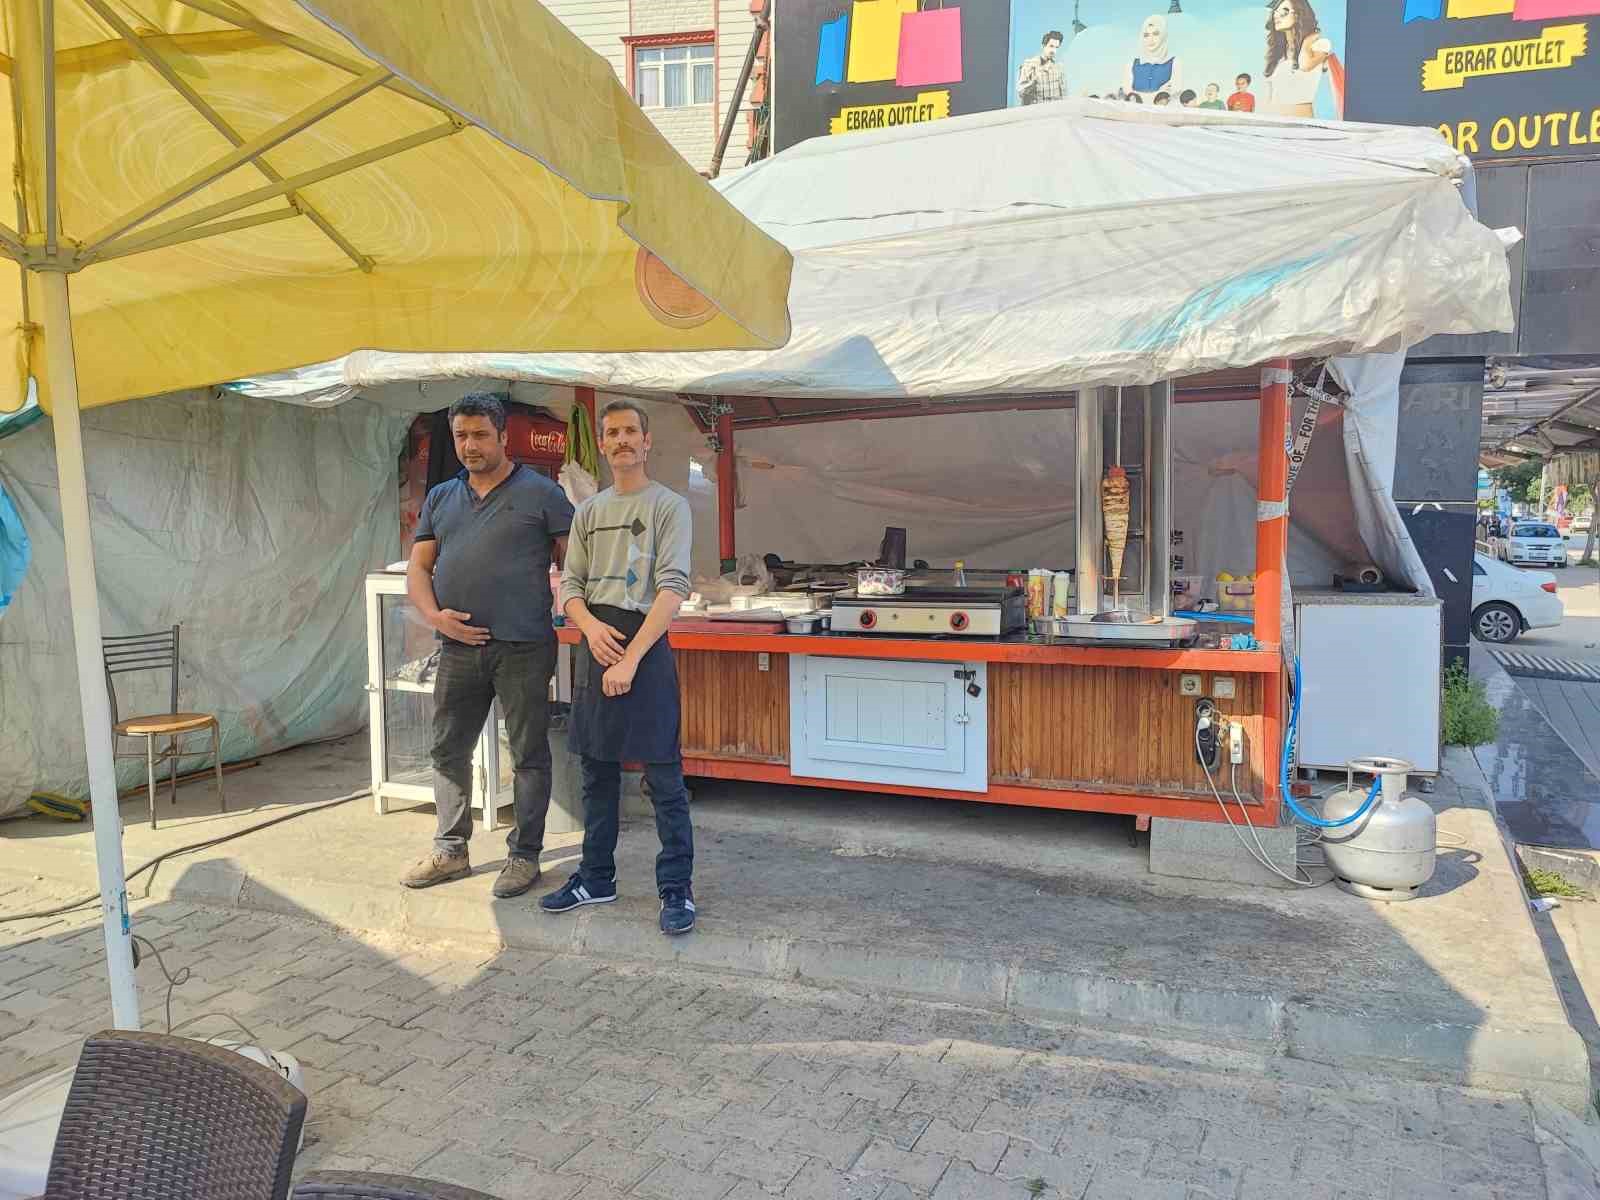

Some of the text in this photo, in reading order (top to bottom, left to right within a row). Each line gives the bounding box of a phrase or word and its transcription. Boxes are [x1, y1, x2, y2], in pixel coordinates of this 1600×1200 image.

[1445, 40, 1565, 74] EBRAR OUTLET
[846, 103, 935, 131] EBRAR OUTLET
[1300, 416, 1314, 439] FOR
